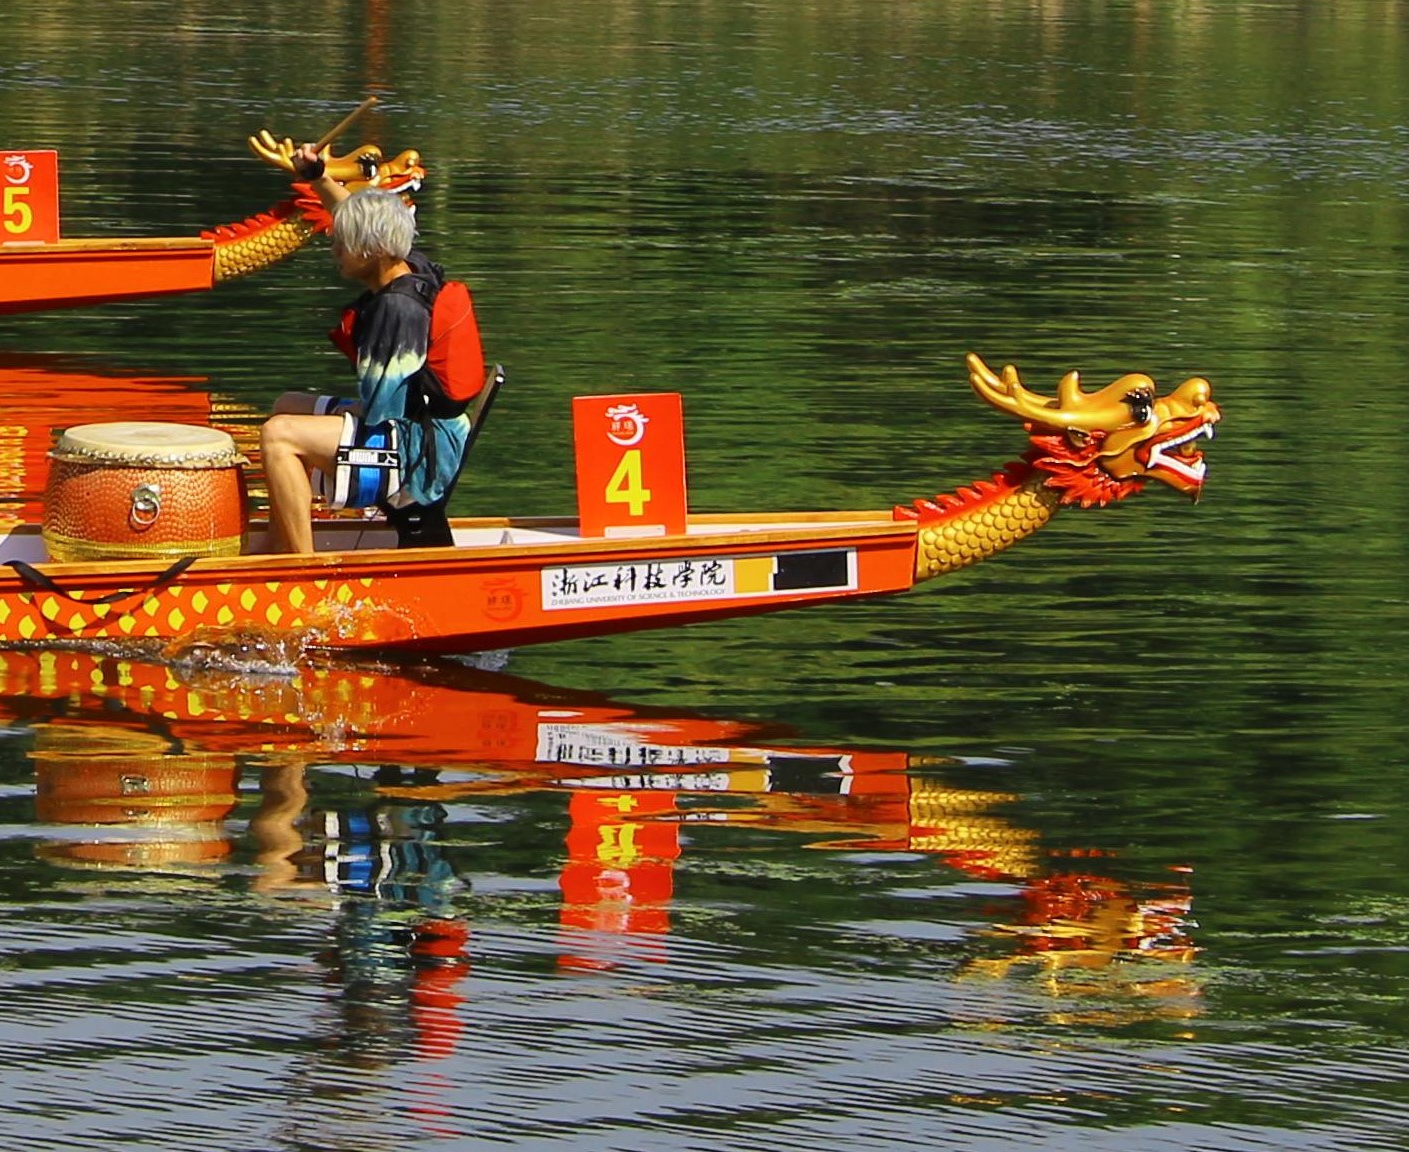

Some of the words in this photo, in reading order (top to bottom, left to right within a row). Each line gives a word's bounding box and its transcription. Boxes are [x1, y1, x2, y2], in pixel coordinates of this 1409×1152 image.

[3, 186, 33, 234] 5
[605, 449, 651, 516] 4
[551, 597, 585, 605] ZHEJIANG
[586, 595, 625, 603] UNIVERSITY
[627, 593, 636, 601] OF
[639, 592, 667, 600] SCIENCE
[678, 589, 725, 597] TECHNOLOGY
